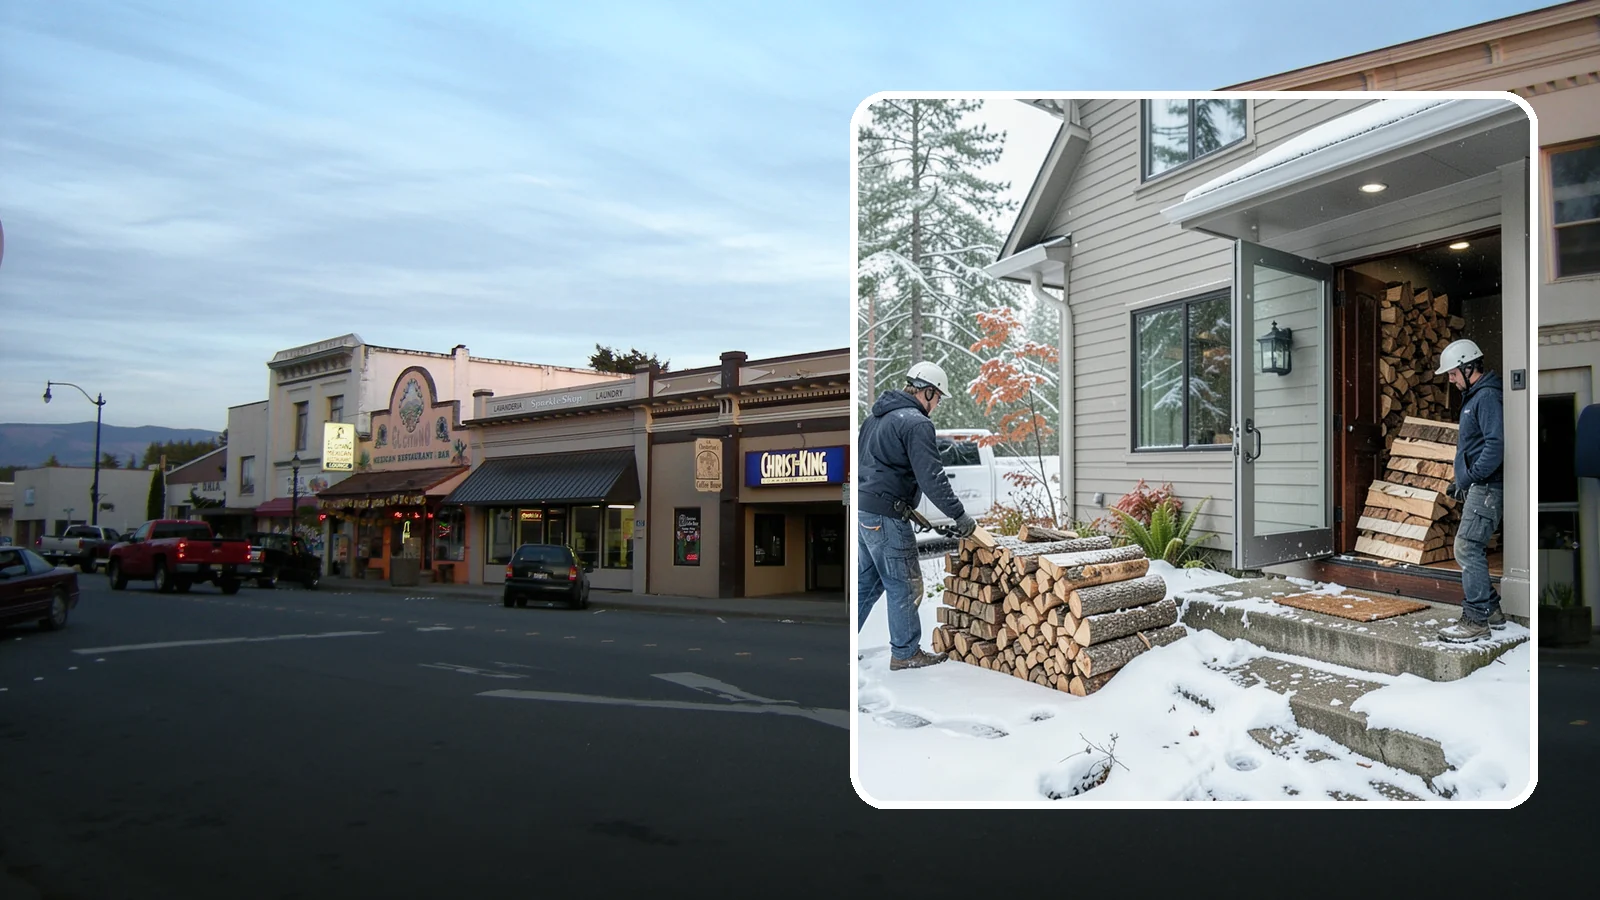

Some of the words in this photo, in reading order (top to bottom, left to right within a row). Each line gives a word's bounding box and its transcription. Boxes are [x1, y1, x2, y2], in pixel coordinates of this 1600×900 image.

[595, 389, 623, 400] LAUNDRY
[493, 402, 522, 413] LAVANDERIA
[531, 397, 560, 409] Sparkle
[561, 395, 582, 406] Shop
[373, 455, 396, 464] MEXICAN
[397, 451, 433, 462] RESTAURANT
[438, 450, 450, 459] BAR
[761, 452, 797, 478] CHRIST
[799, 450, 827, 476] KING
